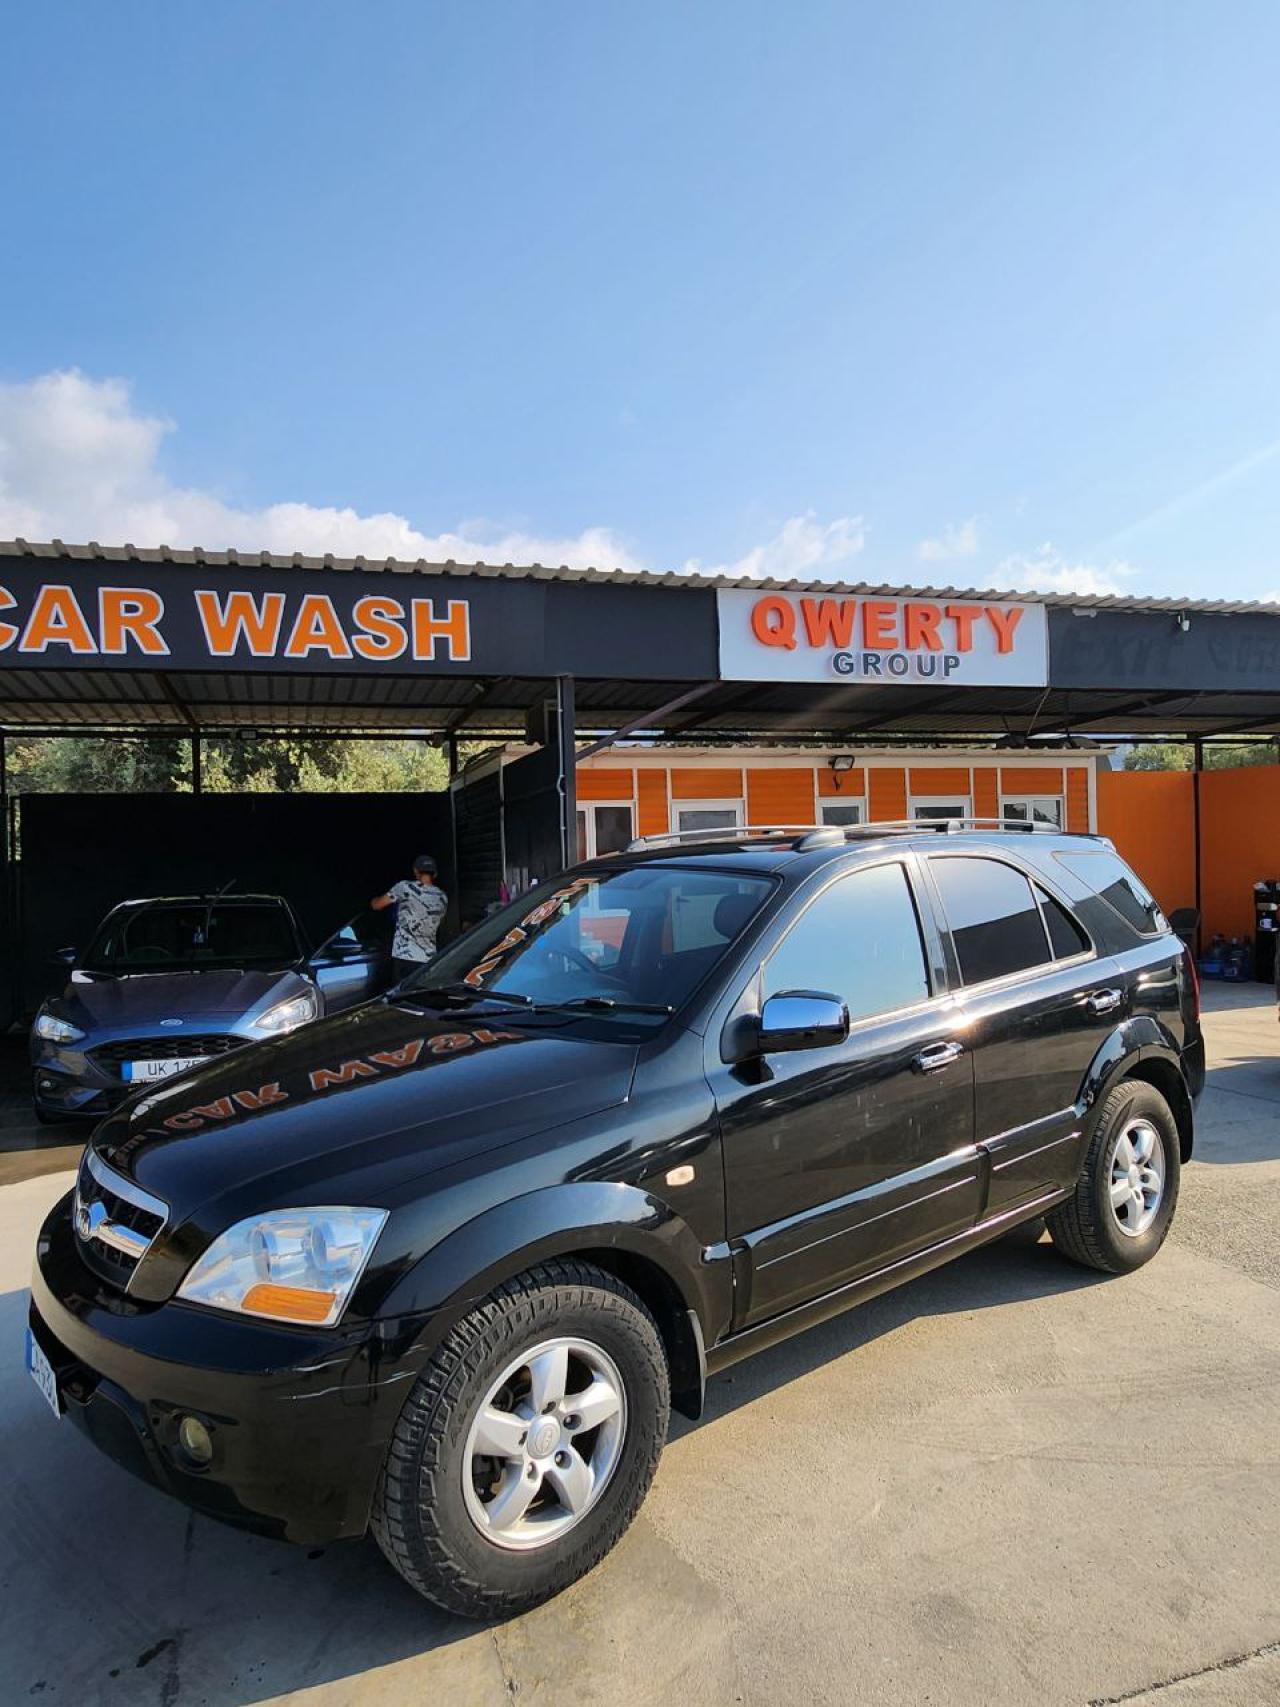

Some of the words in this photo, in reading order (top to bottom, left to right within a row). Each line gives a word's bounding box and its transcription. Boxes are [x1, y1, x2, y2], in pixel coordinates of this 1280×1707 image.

[0, 584, 171, 655] AR
[194, 591, 471, 661] WASH
[751, 595, 1024, 654] QWERTY
[832, 651, 961, 677] GROUP
[147, 1062, 168, 1076] UK
